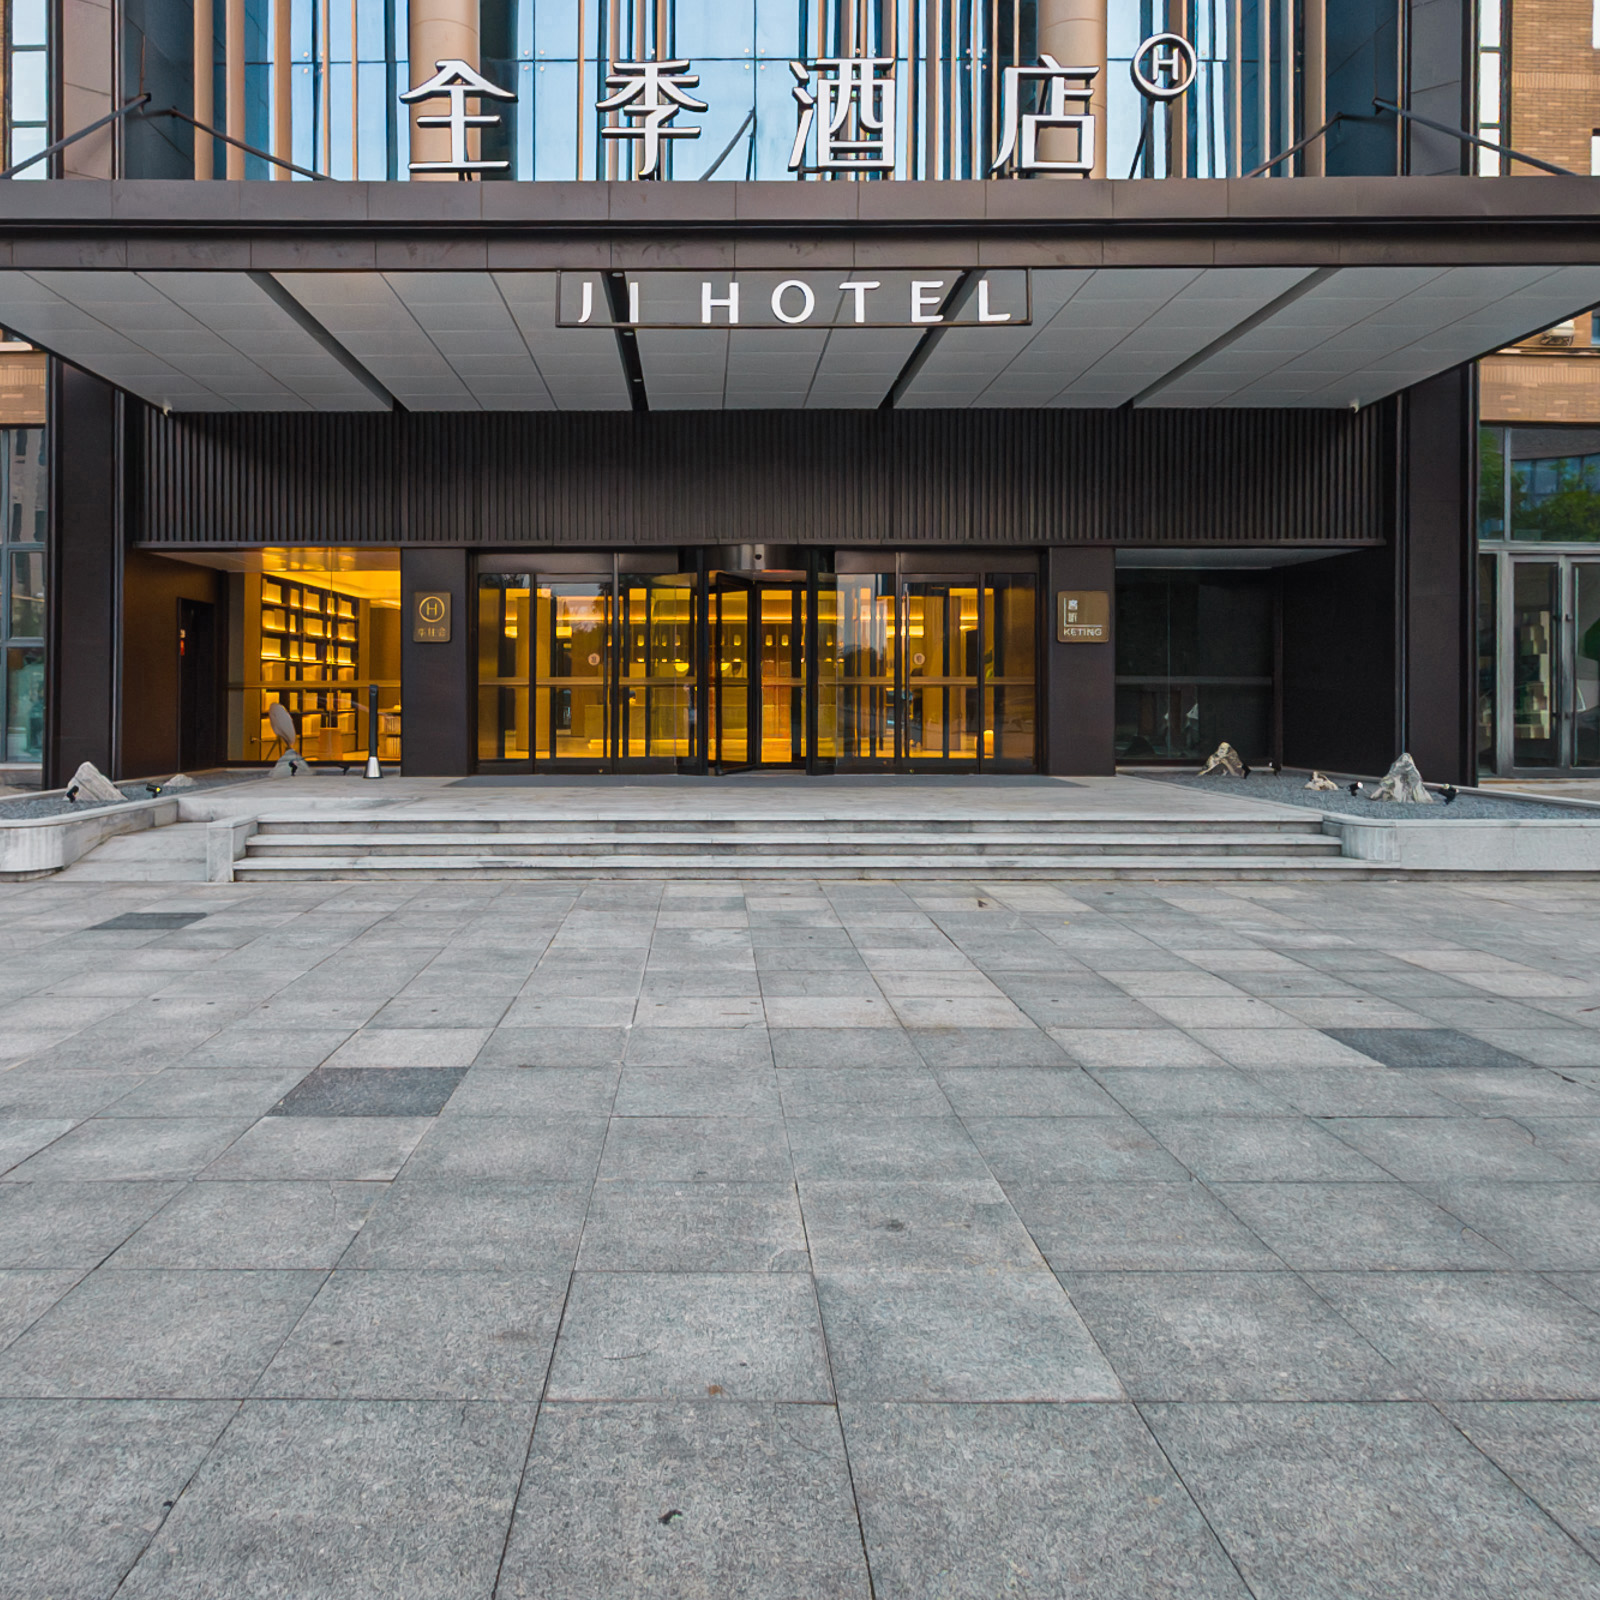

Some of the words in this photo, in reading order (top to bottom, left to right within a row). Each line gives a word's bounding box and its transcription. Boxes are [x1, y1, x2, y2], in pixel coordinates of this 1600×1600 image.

[399, 54, 1101, 179] 全季酒店
[577, 281, 640, 323] JI
[702, 279, 1012, 324] HOTEL
[1063, 628, 1102, 636] KETING
